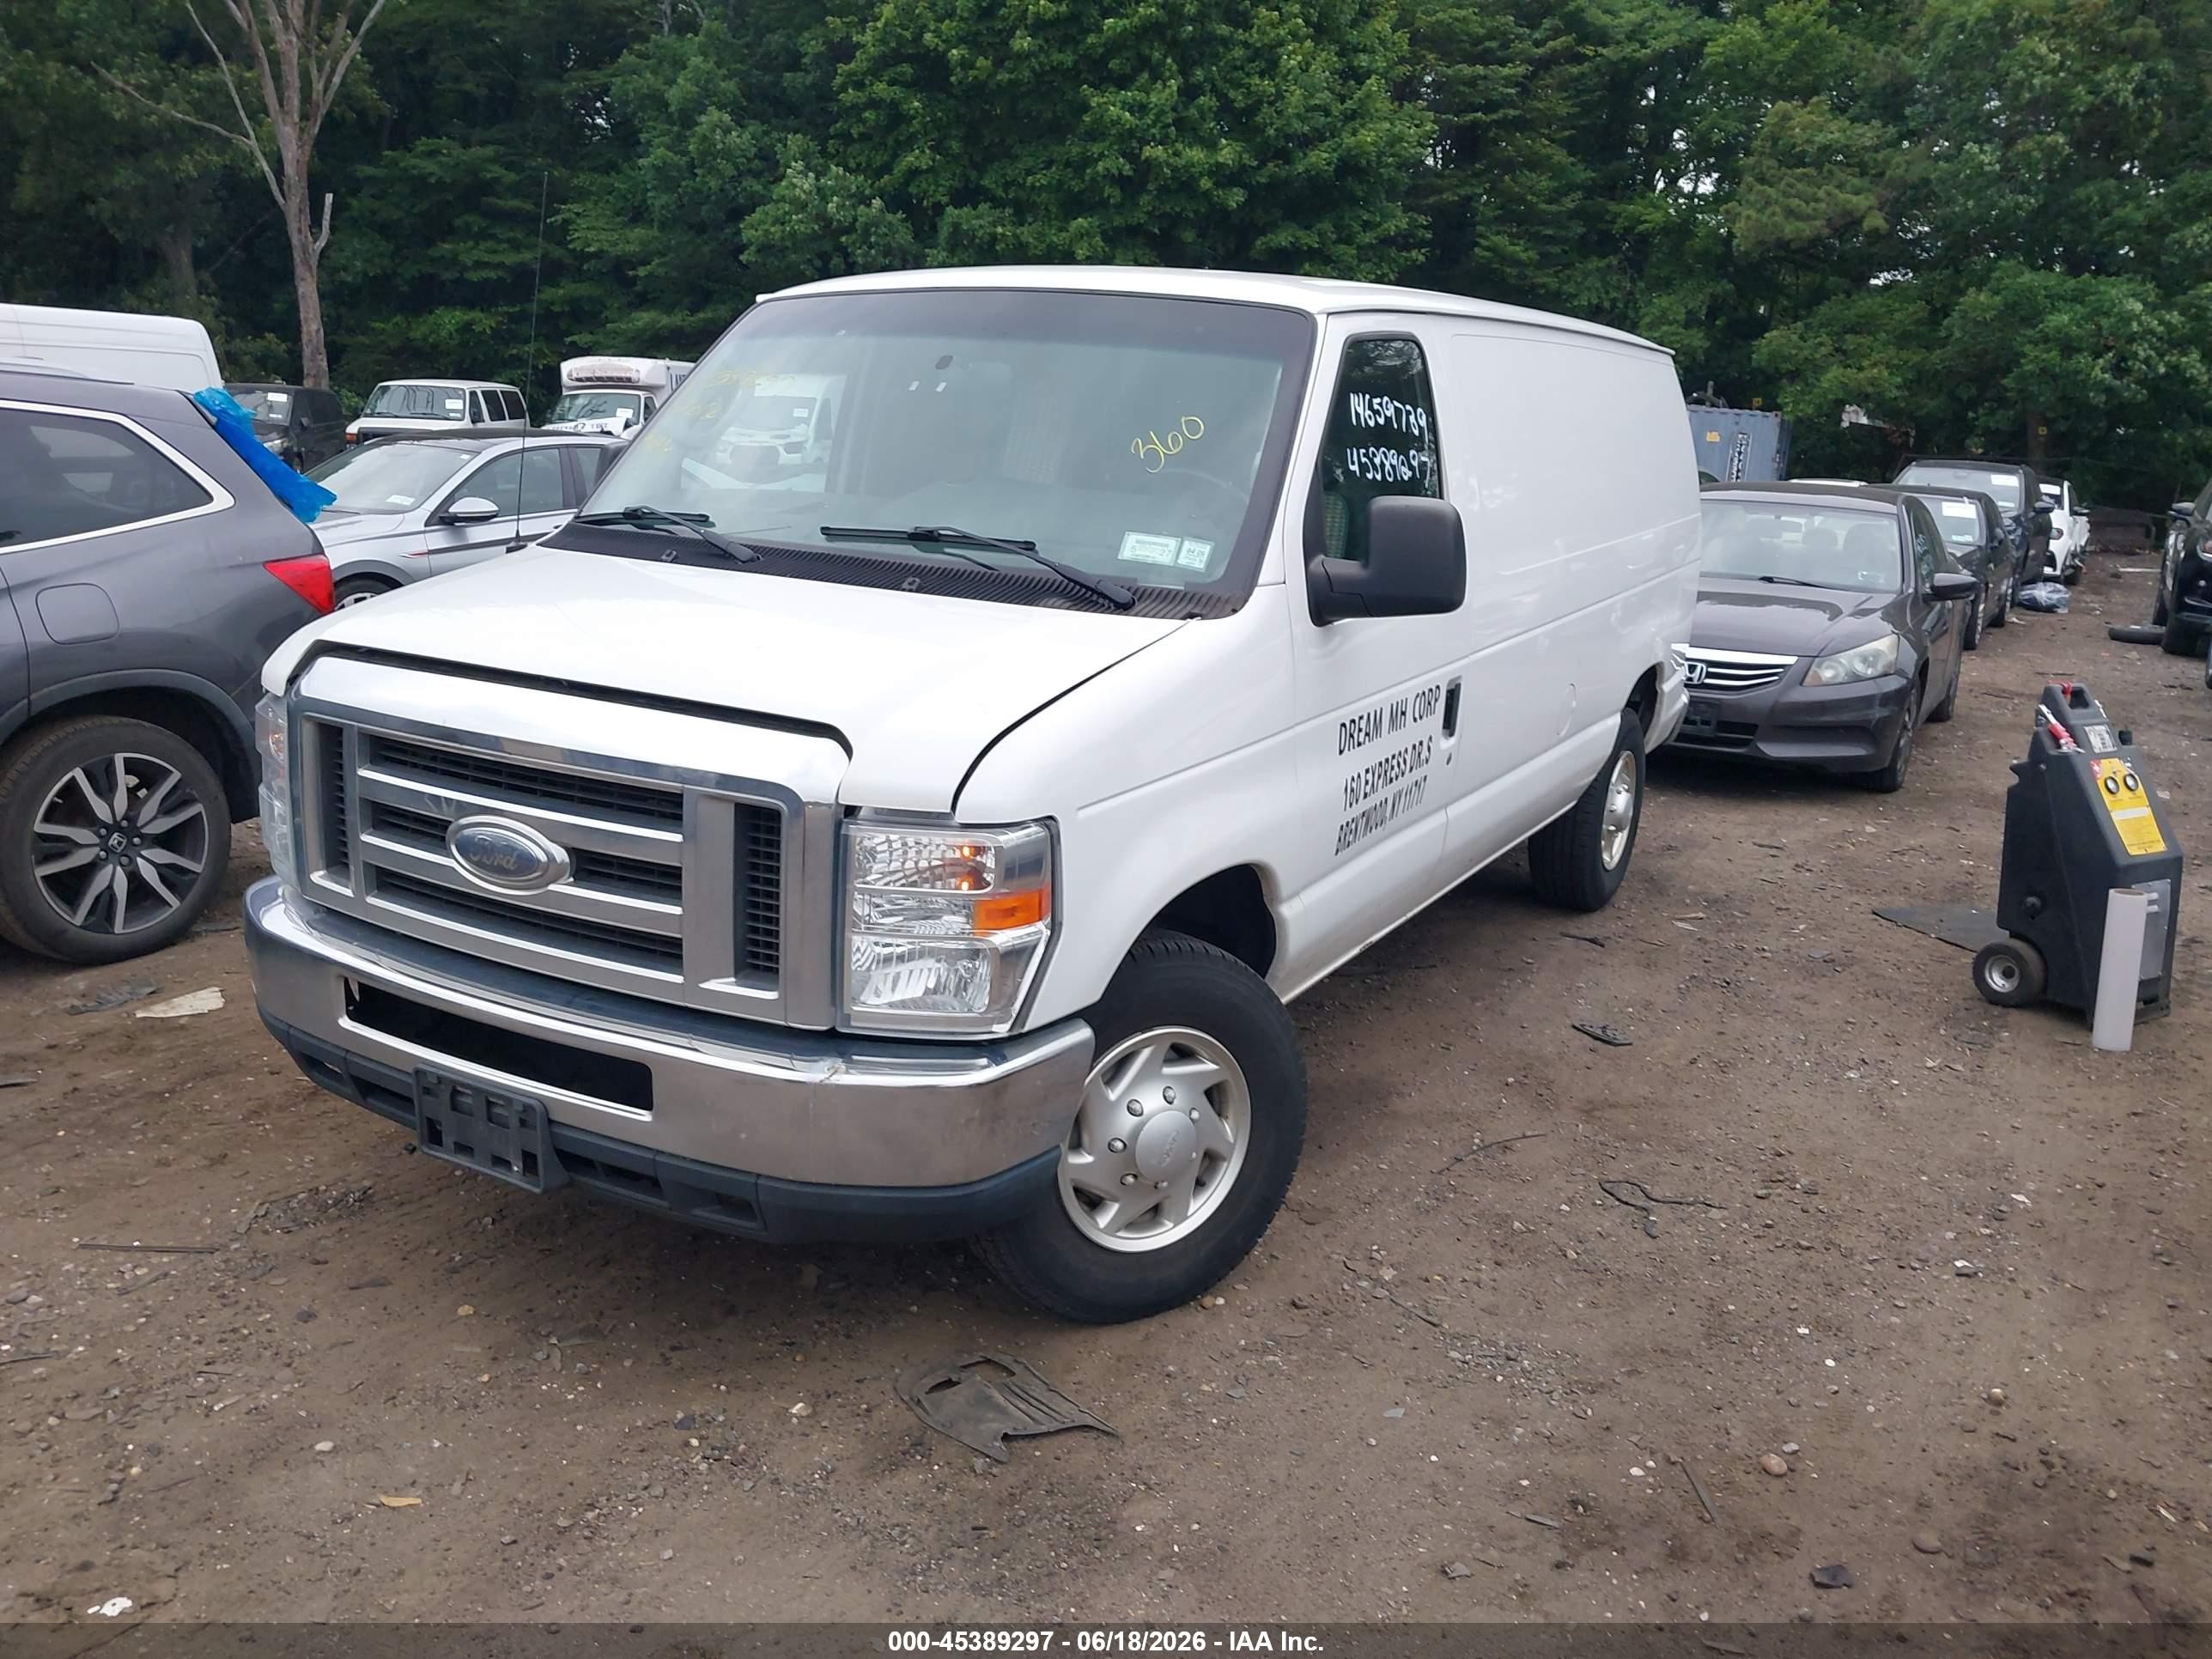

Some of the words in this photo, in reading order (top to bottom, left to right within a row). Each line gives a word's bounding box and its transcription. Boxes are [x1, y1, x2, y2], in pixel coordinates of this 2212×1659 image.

[1130, 415, 1205, 473] 360
[1339, 708, 1383, 756] DREAM
[1388, 698, 1408, 734] MH
[1412, 684, 1441, 723] CORP
[1343, 772, 1361, 811] 160
[1363, 747, 1408, 799] EXPRESS
[1388, 787, 1404, 822] NY
